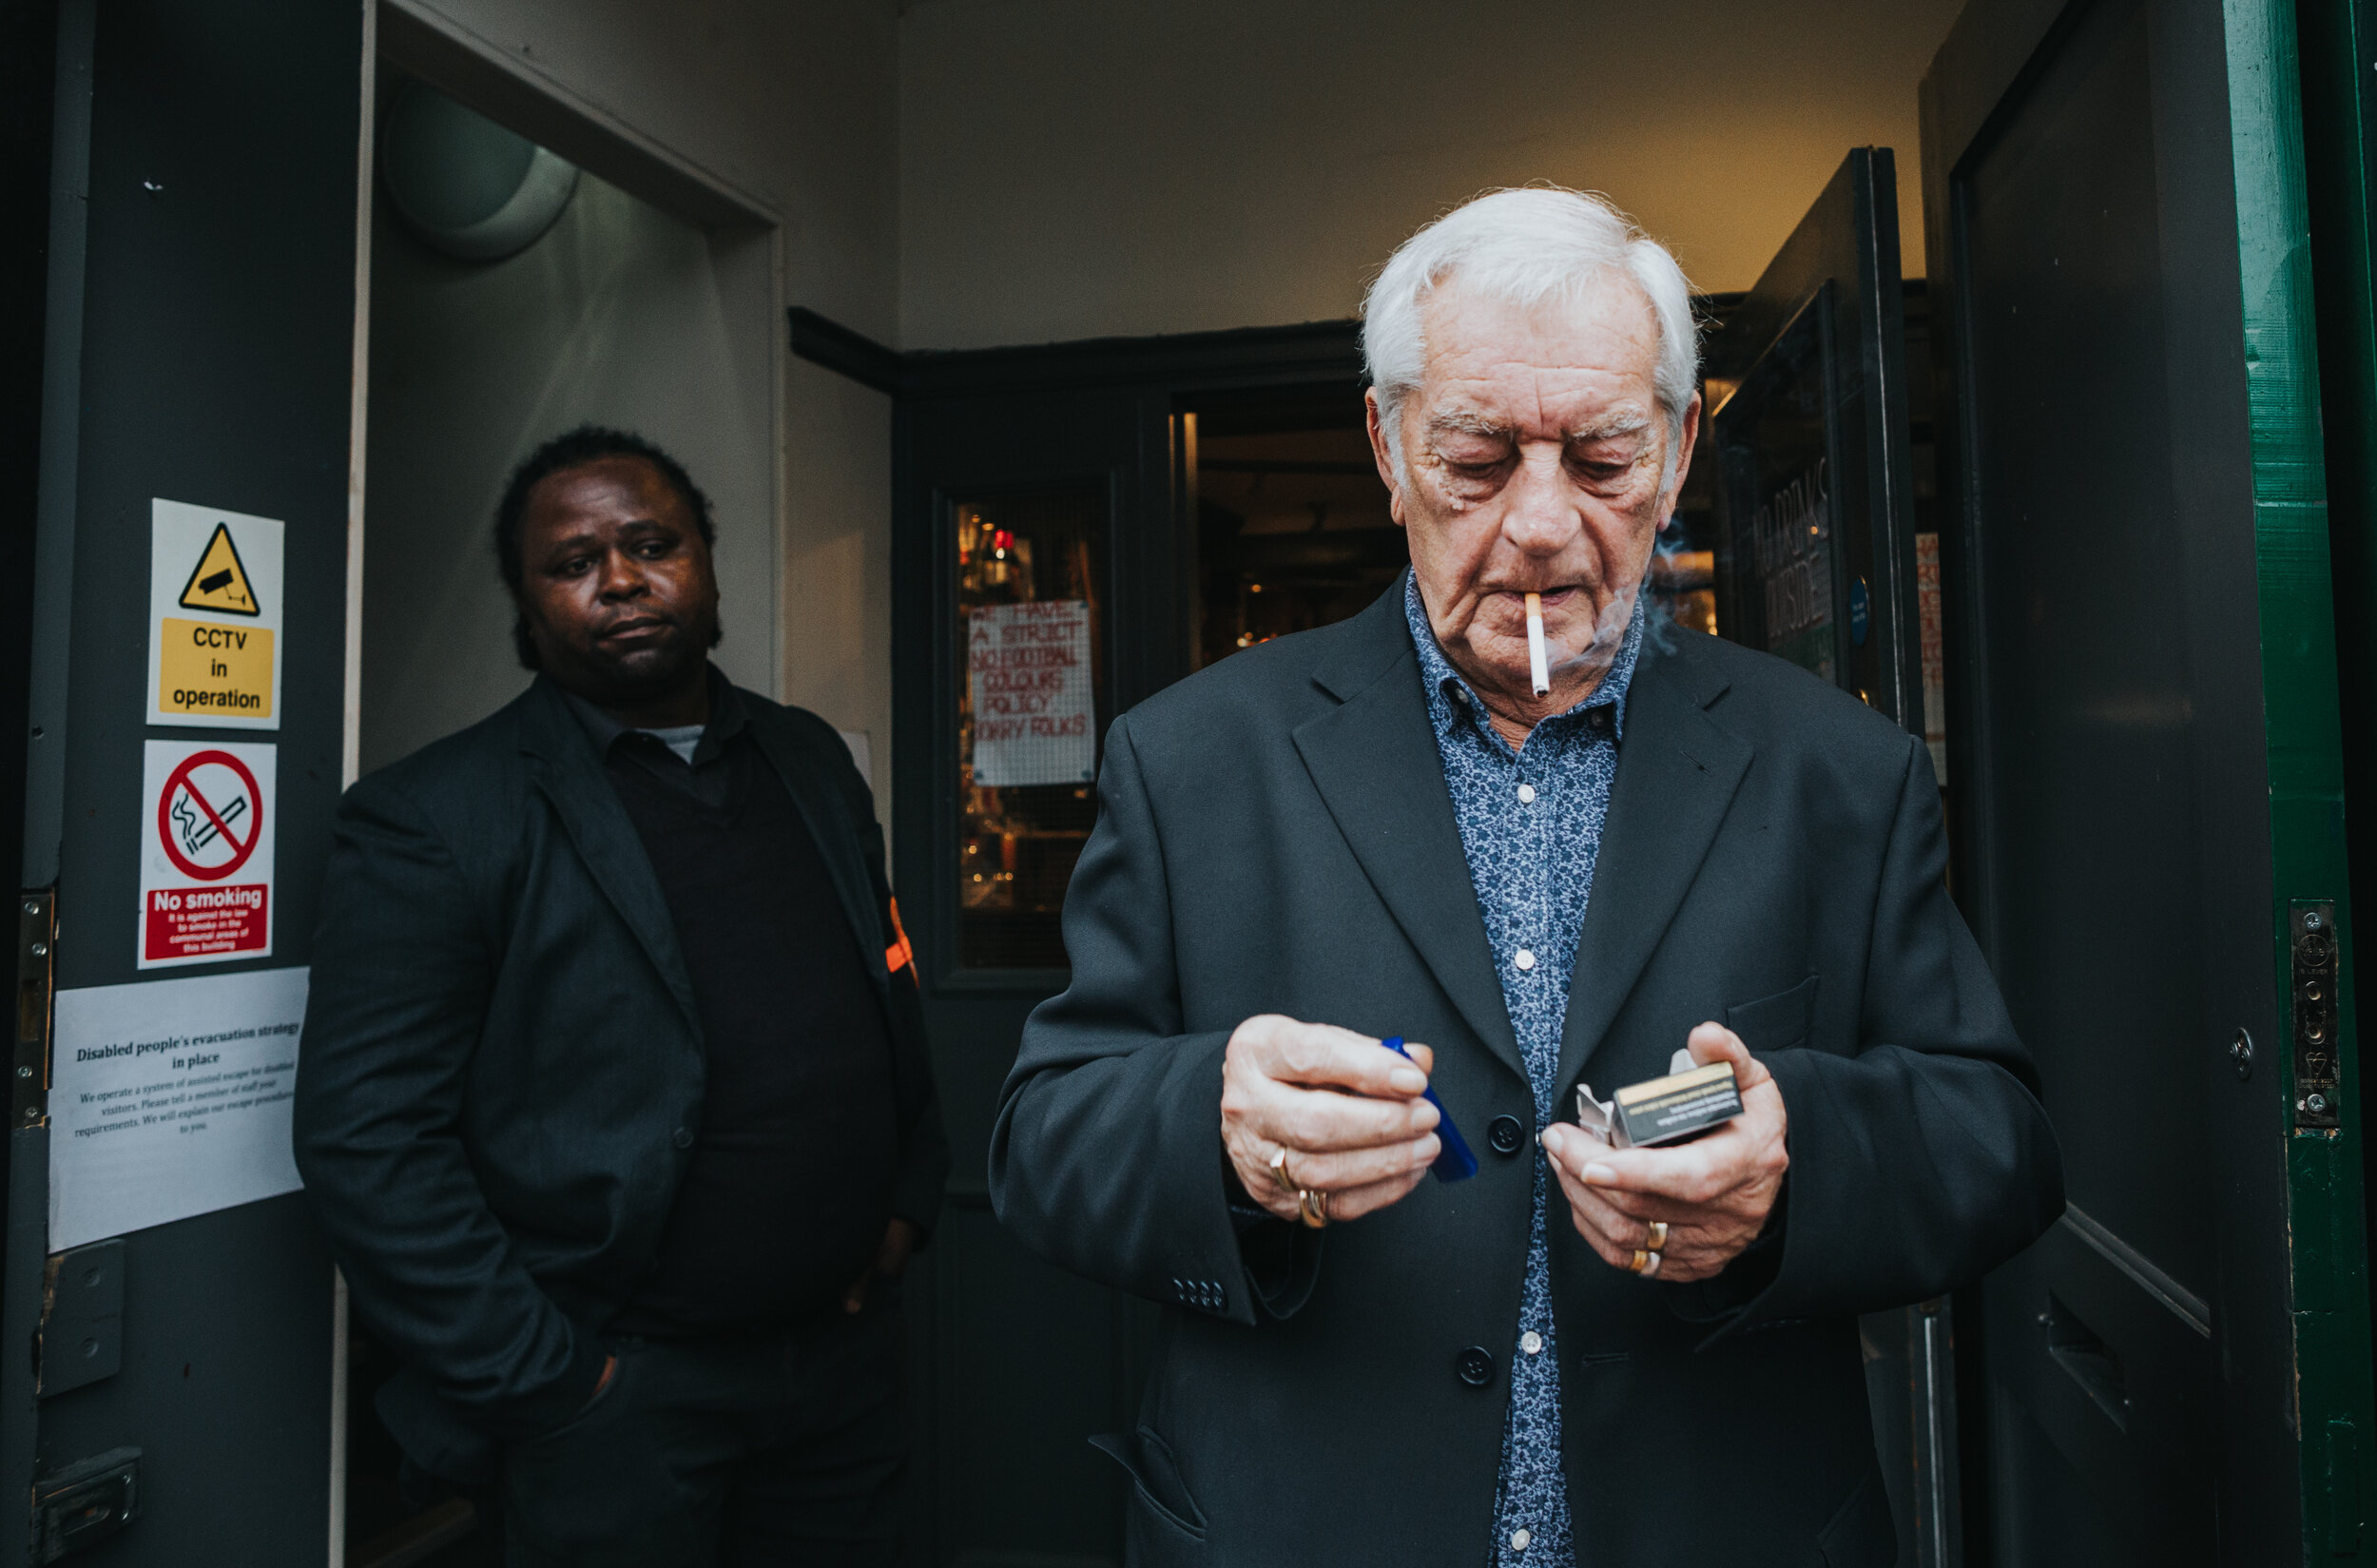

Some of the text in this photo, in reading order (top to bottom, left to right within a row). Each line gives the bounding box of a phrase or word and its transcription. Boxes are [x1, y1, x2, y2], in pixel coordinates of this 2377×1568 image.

[193, 628, 248, 650] CCTV
[970, 620, 1084, 646] A STRICT
[211, 658, 228, 678] in
[969, 648, 996, 671] NO
[983, 668, 1063, 692] COLOURS
[173, 688, 261, 709] operation
[983, 688, 1053, 715] POLICY
[1030, 713, 1086, 737] FOLKS
[154, 886, 262, 911] No smoking
[76, 1041, 133, 1062] Disabled
[136, 1035, 189, 1057] people's
[192, 1027, 256, 1046] evacuation
[172, 1053, 220, 1070] in place
[80, 1093, 95, 1103] We
[97, 1088, 132, 1102] operate
[135, 1087, 141, 1095] a
[143, 1082, 174, 1096] system
[176, 1076, 185, 1087] of
[101, 1102, 139, 1115] visitors.
[141, 1096, 170, 1110] Please
[171, 1093, 185, 1104] tell
[75, 1117, 140, 1138] requirements.
[142, 1113, 158, 1125] We
[159, 1109, 177, 1122] will
